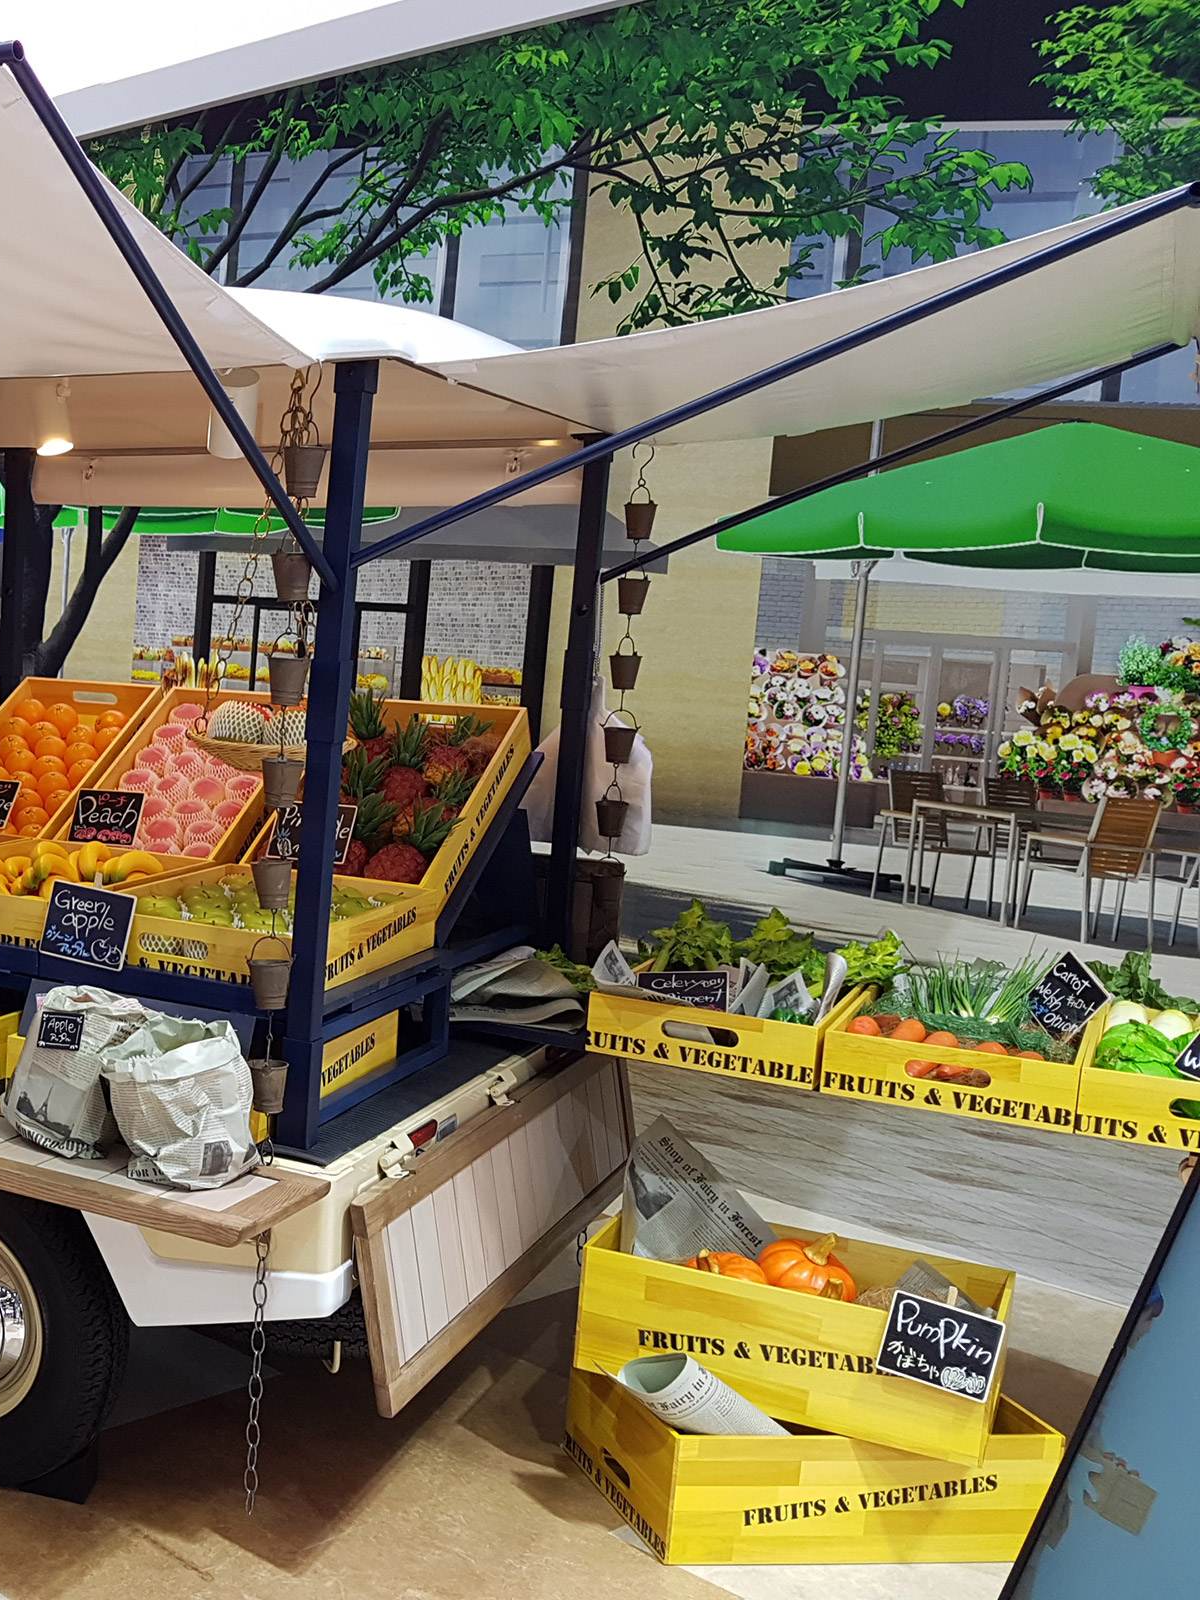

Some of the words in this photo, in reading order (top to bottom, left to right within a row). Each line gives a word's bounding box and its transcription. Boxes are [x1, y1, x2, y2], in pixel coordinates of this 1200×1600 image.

[79, 796, 138, 829] Peach
[444, 838, 469, 895] FRUITS
[475, 743, 515, 827] VEGETABLES
[54, 889, 107, 913] Green
[61, 905, 115, 940] apple
[366, 906, 417, 954] VEGETABLES
[651, 974, 703, 992] Celery
[1053, 962, 1092, 996] Carrot
[1035, 982, 1066, 1012] Welsh
[47, 1017, 77, 1034] Apple
[321, 1032, 376, 1087] VEGETABLES
[653, 1042, 670, 1060] &
[678, 1046, 814, 1085] VEGETABLE
[823, 1070, 915, 1101] FRUITS
[924, 1087, 942, 1106] &
[952, 1091, 1073, 1127] VEGETAB
[1147, 1124, 1167, 1144] &
[660, 1136, 683, 1164] Shop
[693, 1172, 719, 1204] Fairy
[637, 1329, 725, 1356] FRUITS
[733, 1341, 751, 1359] &
[887, 1340, 940, 1379] かぼちゃ
[657, 1390, 696, 1411] Fairy
[692, 1378, 705, 1392] in
[595, 1468, 602, 1487] &
[604, 1476, 667, 1560] VEGETABLES
[743, 1499, 826, 1526] FRUITS
[834, 1496, 851, 1513] &
[858, 1474, 998, 1510] VEGETABLES
